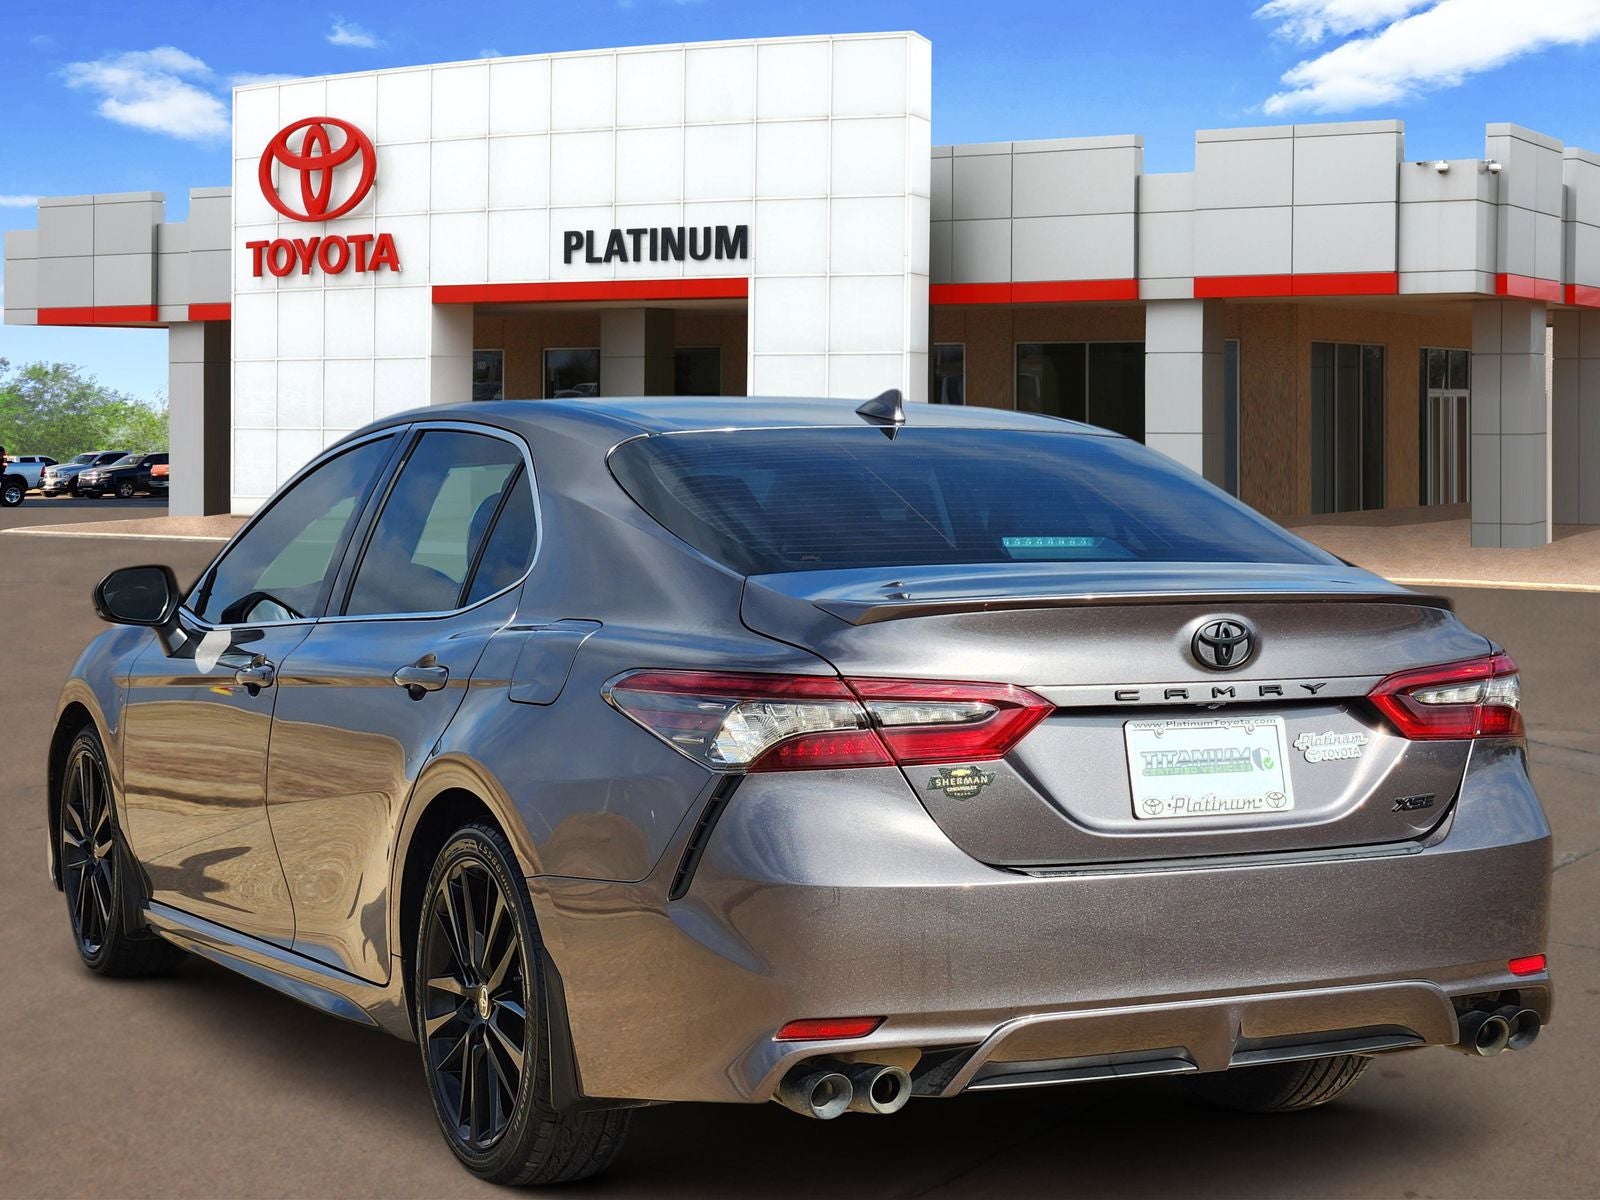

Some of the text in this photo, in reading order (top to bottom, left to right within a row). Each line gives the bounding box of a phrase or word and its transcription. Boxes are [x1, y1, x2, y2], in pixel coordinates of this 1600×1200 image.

[246, 232, 400, 277] TOYOTA
[563, 225, 749, 265] PLATINUM
[1114, 682, 1327, 701] CAMRY
[1133, 718, 1277, 730] www.PlatinumToyota.com
[1295, 731, 1368, 750] Platinum
[1140, 747, 1250, 769] TITANIUM
[1321, 746, 1362, 761] TOYOTA
[935, 775, 988, 787] SHERMAN
[1171, 793, 1263, 814] Platinum
[1391, 792, 1436, 812] XSE
